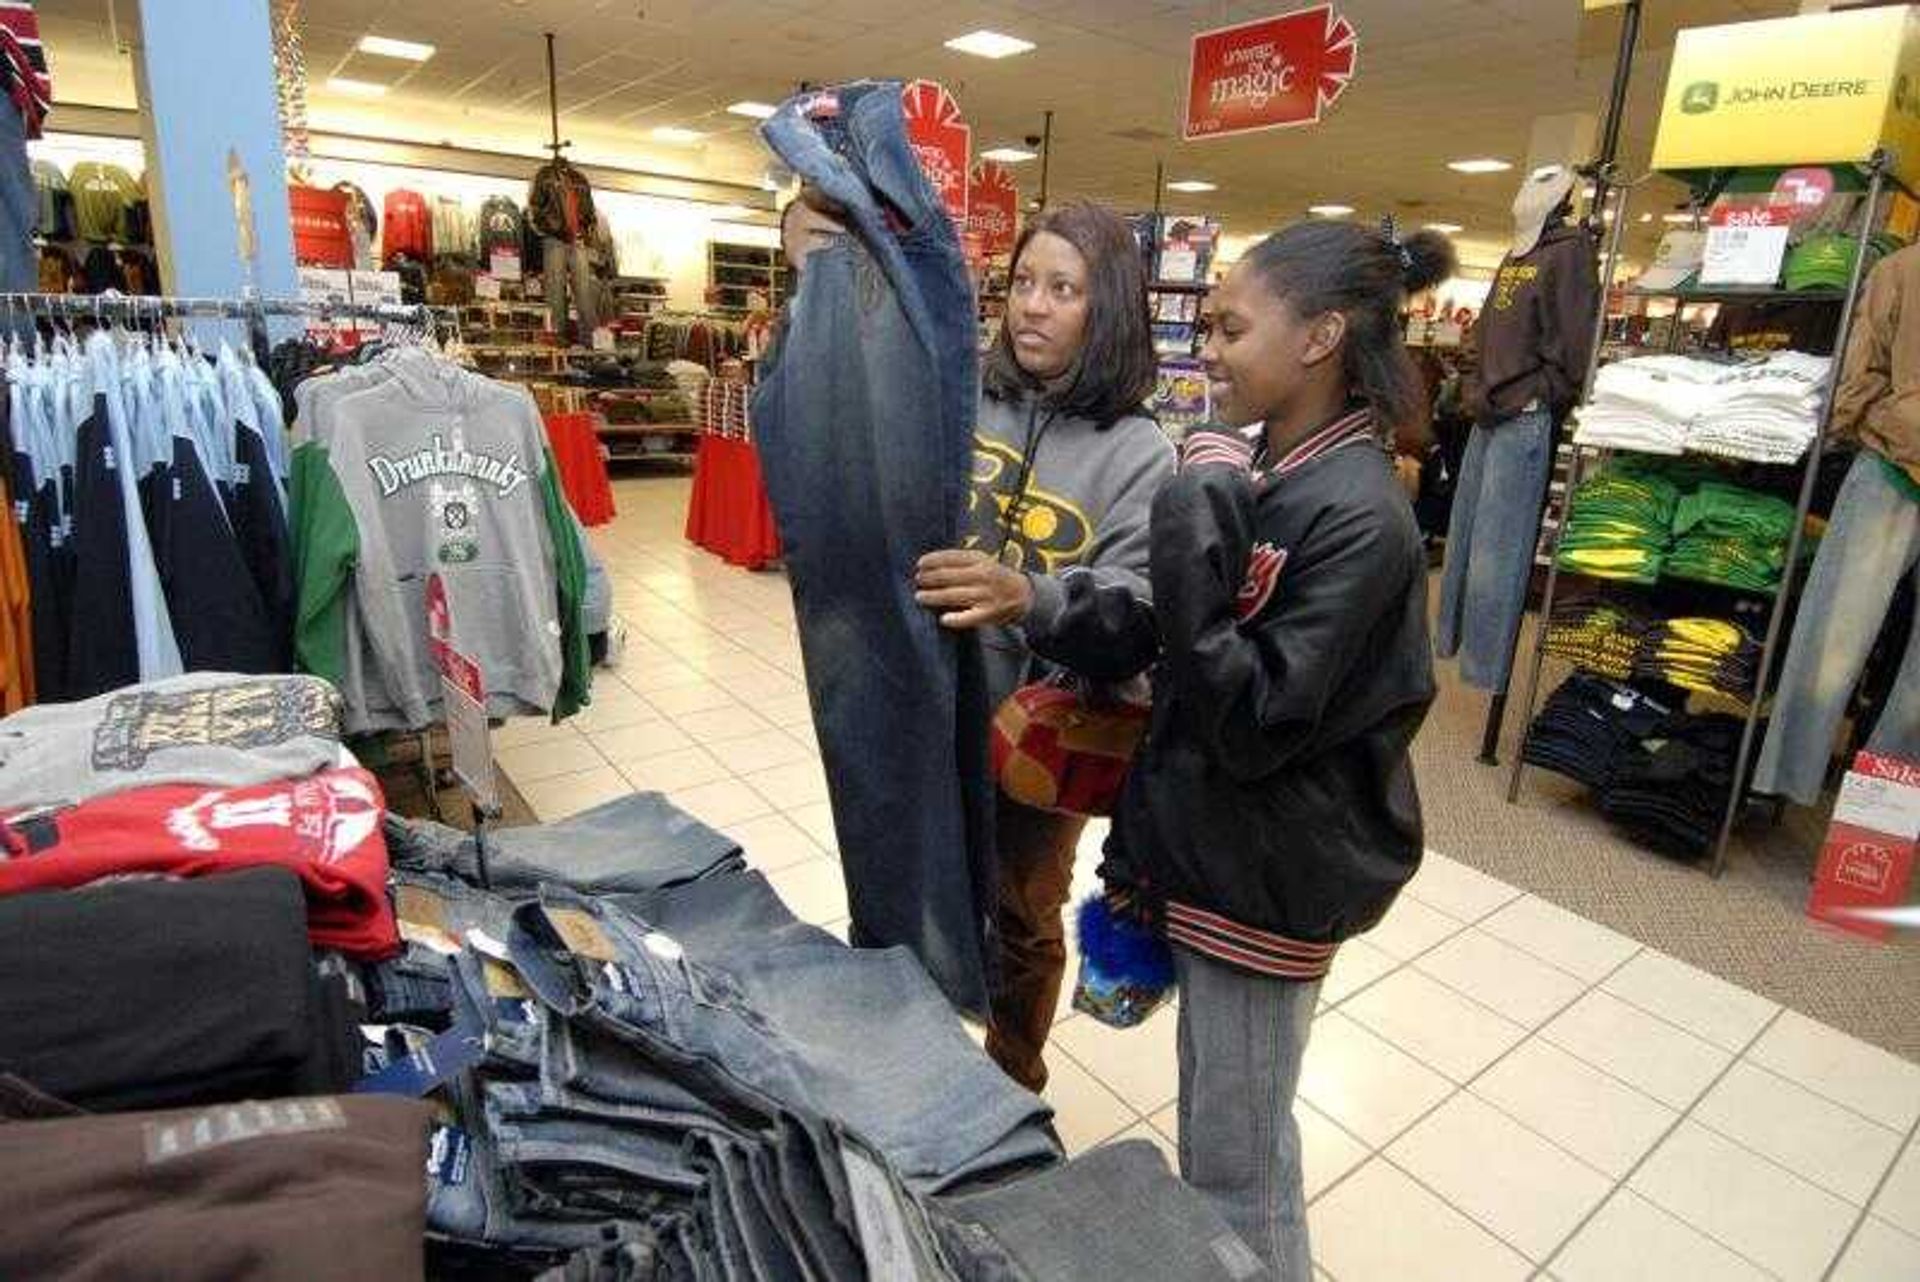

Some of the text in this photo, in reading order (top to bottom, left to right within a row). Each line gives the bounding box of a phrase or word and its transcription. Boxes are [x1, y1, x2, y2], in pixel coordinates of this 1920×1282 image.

[1210, 54, 1295, 110] magic
[1724, 80, 1867, 104] JOHN DEERE
[1727, 205, 1772, 228] sale
